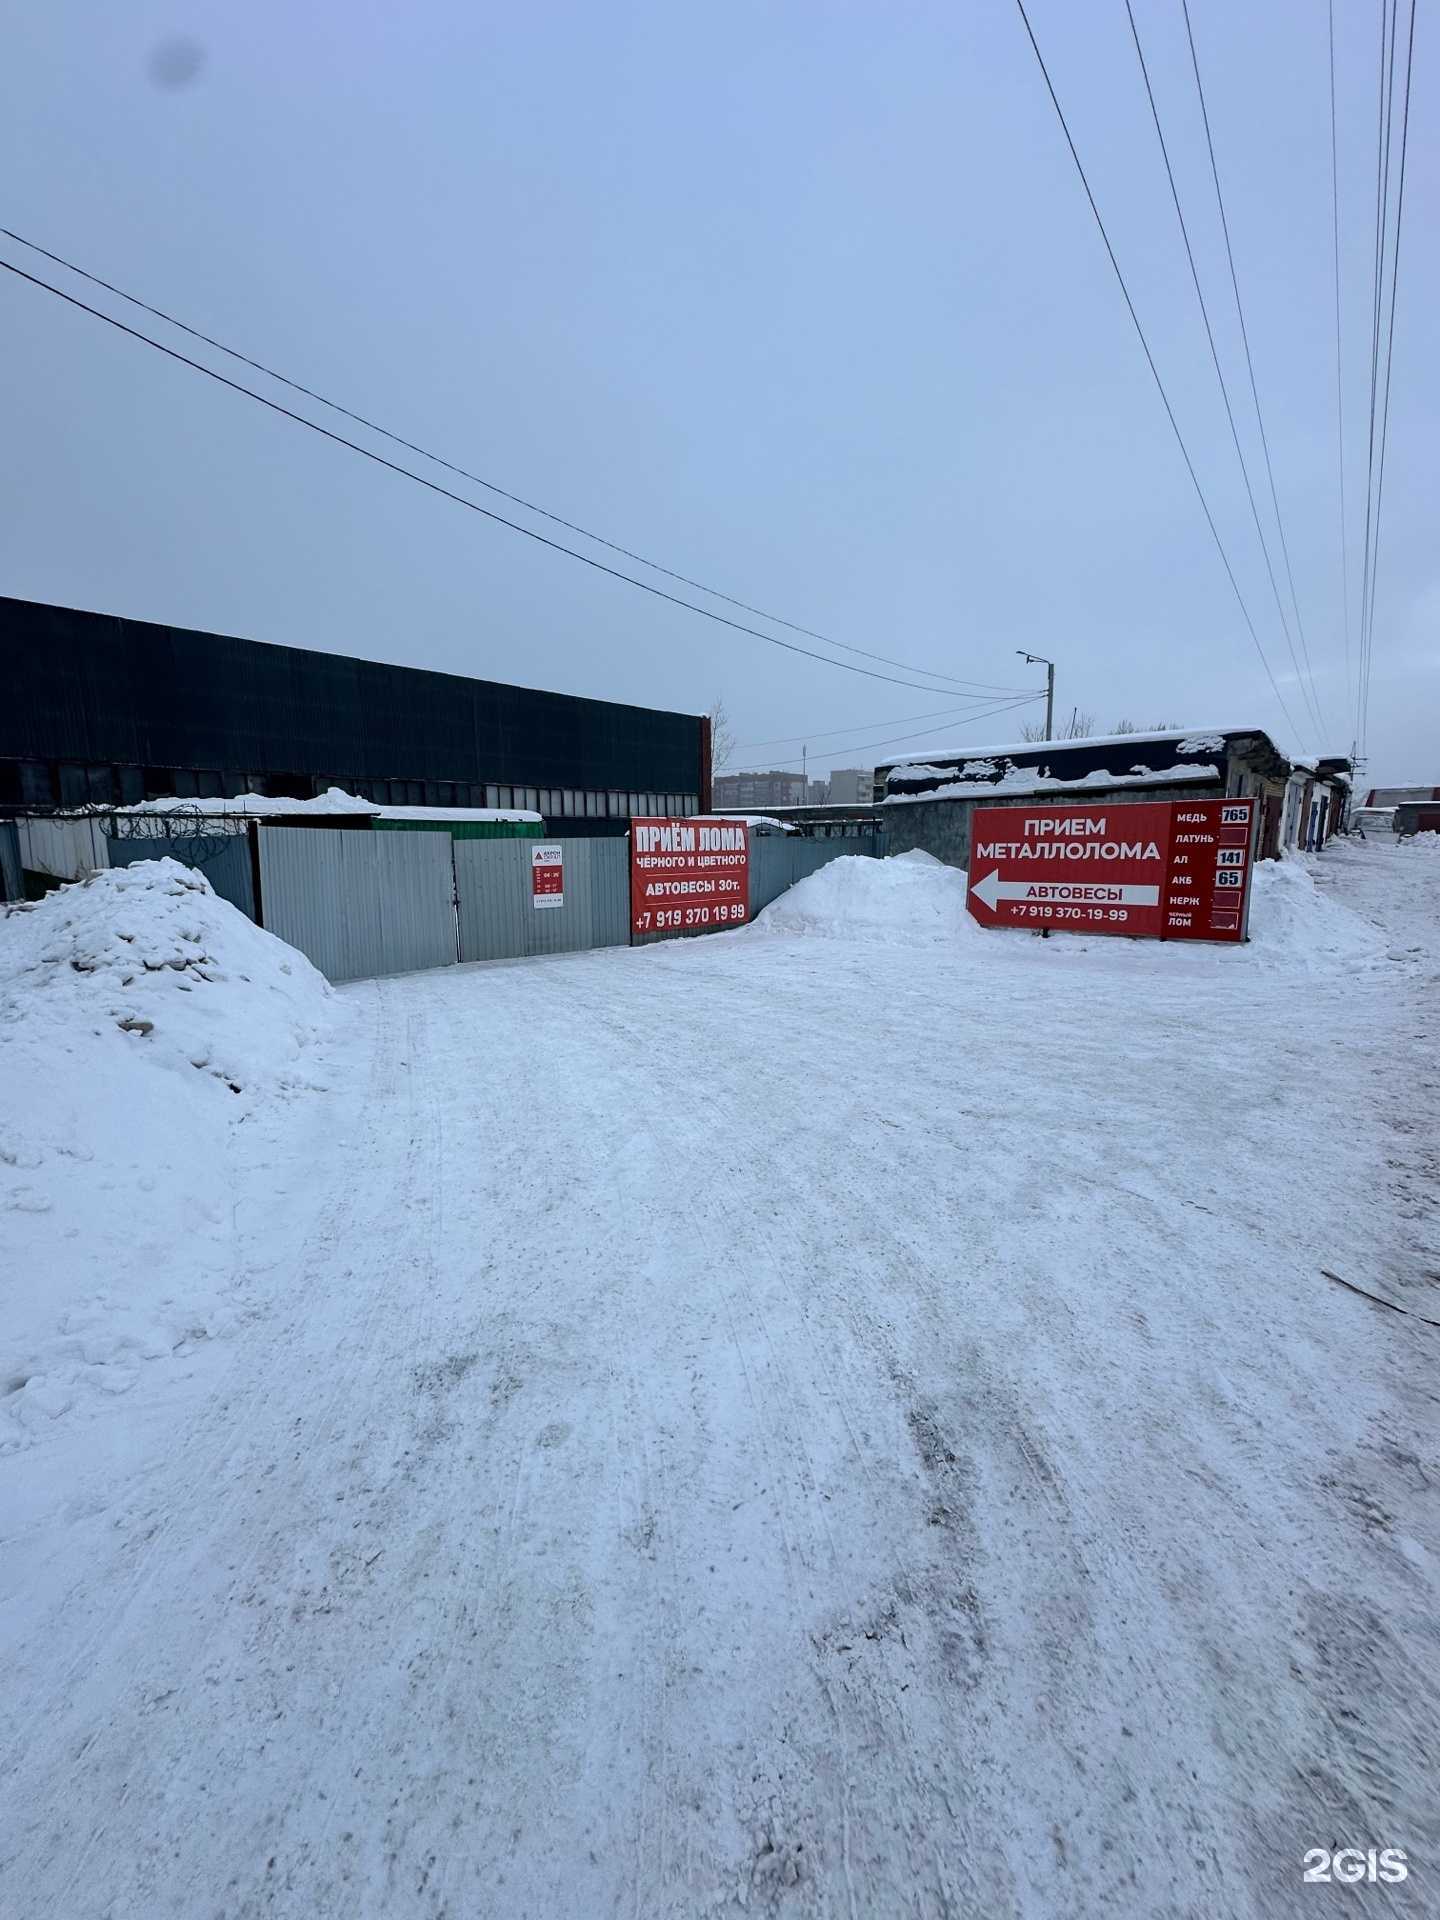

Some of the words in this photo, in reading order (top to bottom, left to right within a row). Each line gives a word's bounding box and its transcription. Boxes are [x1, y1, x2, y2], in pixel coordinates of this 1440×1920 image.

[1176, 813, 1207, 823] МЕДЬ
[1223, 808, 1248, 822] 765
[1023, 818, 1107, 837] ПРИЕМ
[636, 822, 695, 852] ПРИЁМ
[699, 827, 745, 851] ЛОМА
[1175, 834, 1214, 844] ЛАТУНЬ
[976, 841, 1161, 861] МЕТАЛЛОЛОМА
[1173, 856, 1189, 865] АЛ
[1220, 852, 1241, 864] 141
[687, 856, 695, 867] И
[697, 855, 746, 868] ЦВЕТНОГО
[1171, 876, 1193, 885] АКБ
[1218, 871, 1239, 886] 65
[645, 880, 715, 897] АВТОВЕСЫ
[1026, 886, 1123, 901] АВТОВЕСЫ
[1169, 897, 1201, 906] НЕРЖ
[636, 911, 651, 929] +7
[656, 909, 682, 928] 919
[685, 907, 710, 925] 370
[713, 905, 728, 921] 19
[731, 903, 745, 919] 99
[1010, 905, 1028, 917] +7
[1029, 906, 1053, 918] 919
[1055, 907, 1129, 922] 370-19-99
[1167, 917, 1192, 927] ЛОМ
